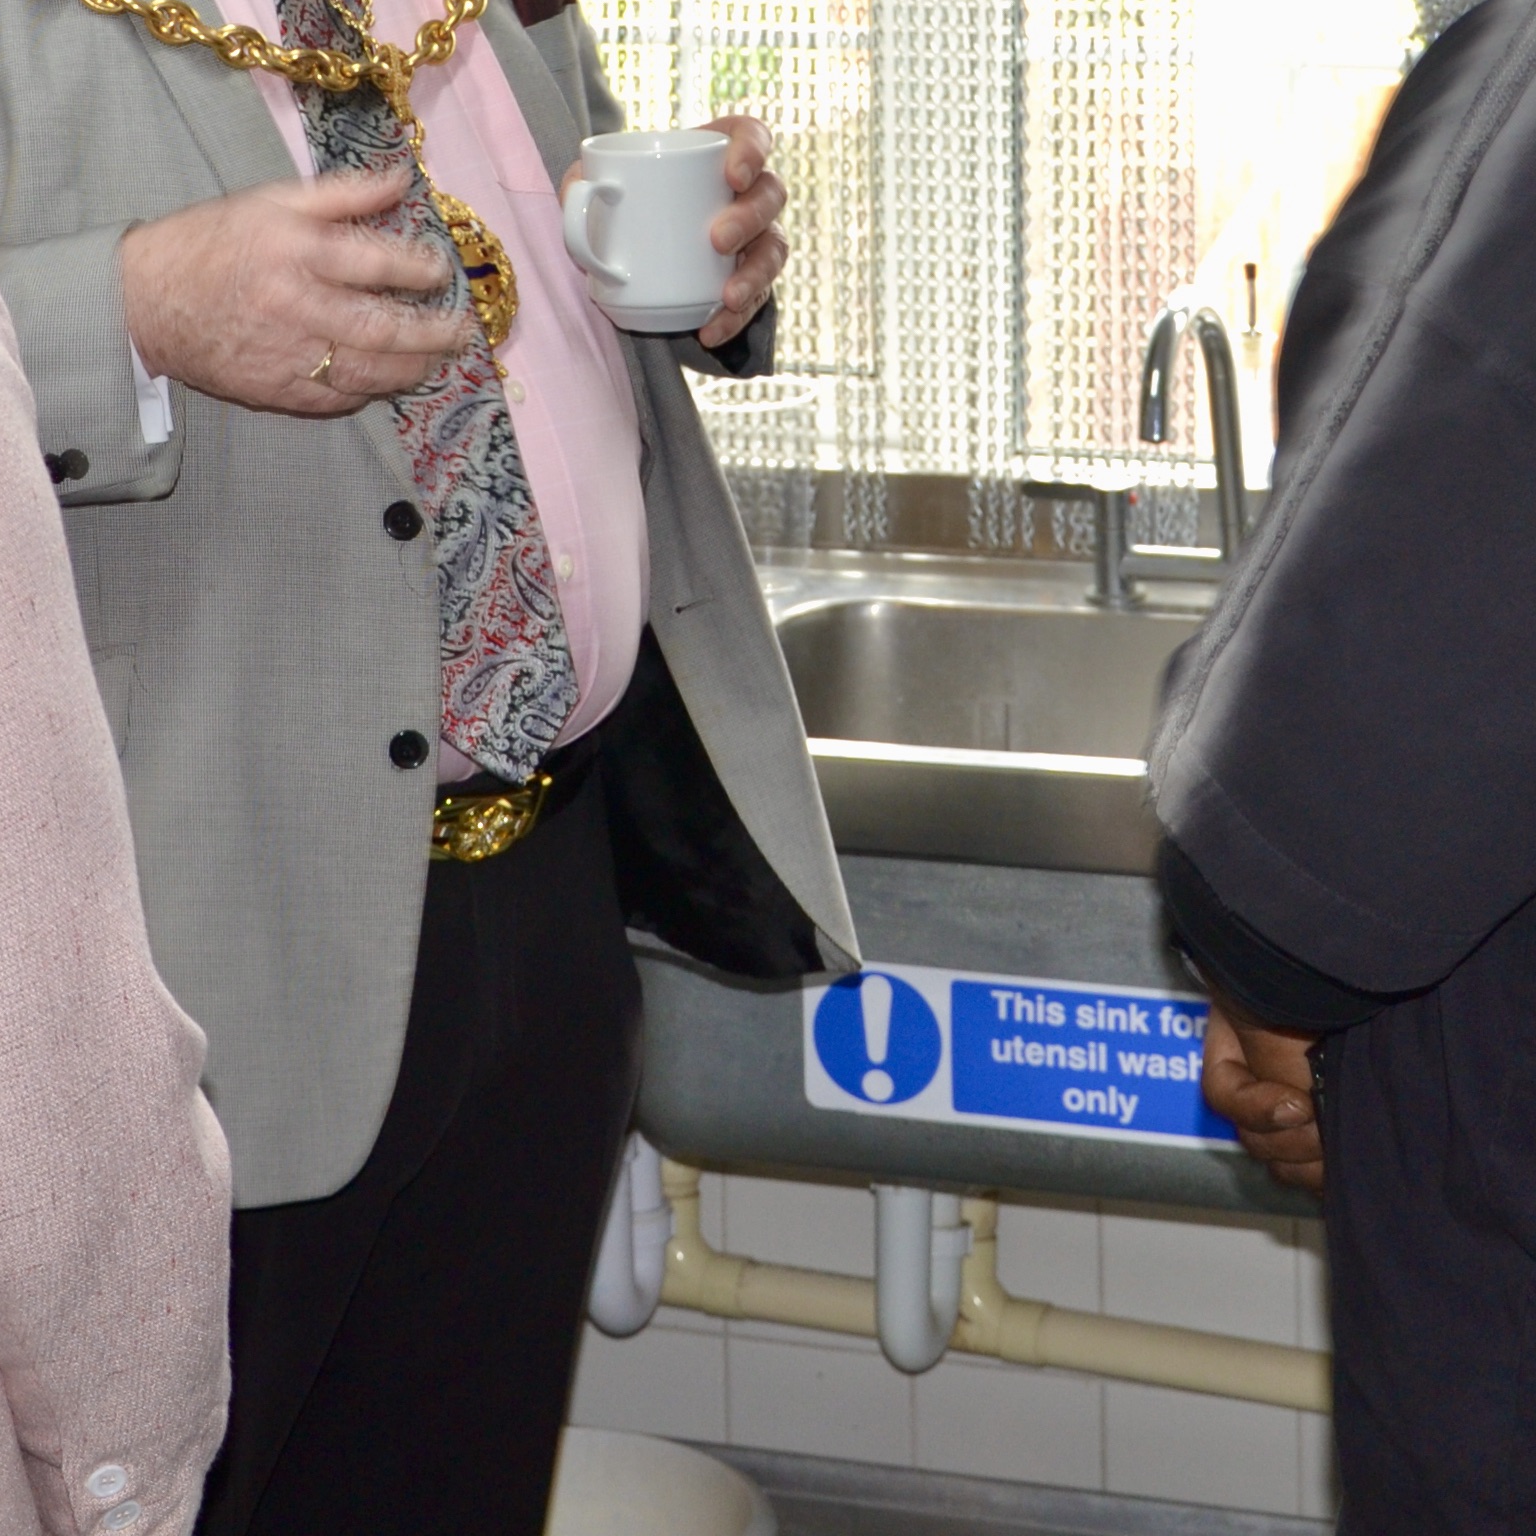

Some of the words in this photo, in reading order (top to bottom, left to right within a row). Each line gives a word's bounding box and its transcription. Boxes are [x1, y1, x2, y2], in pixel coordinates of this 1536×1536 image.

[991, 990, 1066, 1026] This
[1076, 1001, 1150, 1038] sink
[1159, 1006, 1208, 1039] for
[991, 1038, 1109, 1074] utensil
[1062, 1086, 1138, 1124] only
